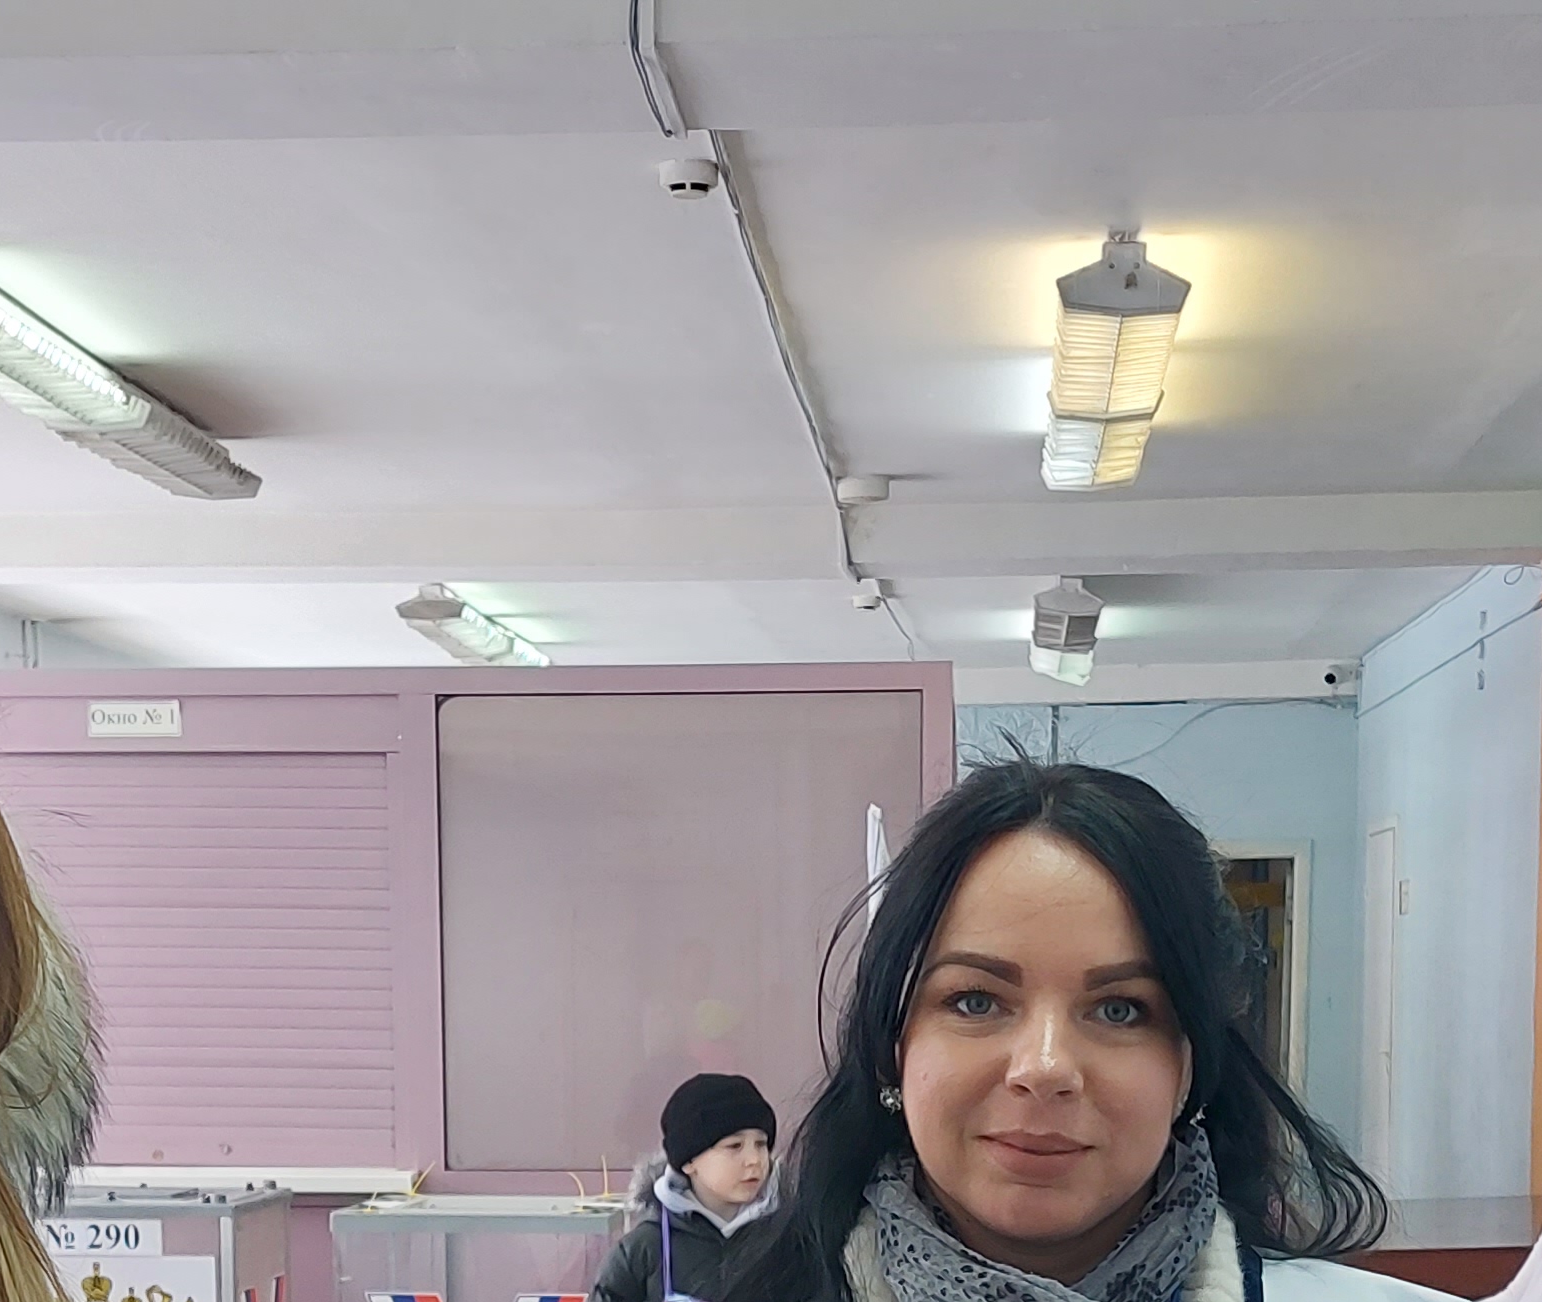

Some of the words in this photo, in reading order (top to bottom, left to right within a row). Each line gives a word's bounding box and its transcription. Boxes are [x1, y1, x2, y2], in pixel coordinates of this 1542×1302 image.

[91, 709, 138, 725] Окно
[142, 709, 163, 725] №
[170, 709, 175, 724] 1
[46, 1224, 76, 1250] №
[86, 1223, 141, 1250] 290
